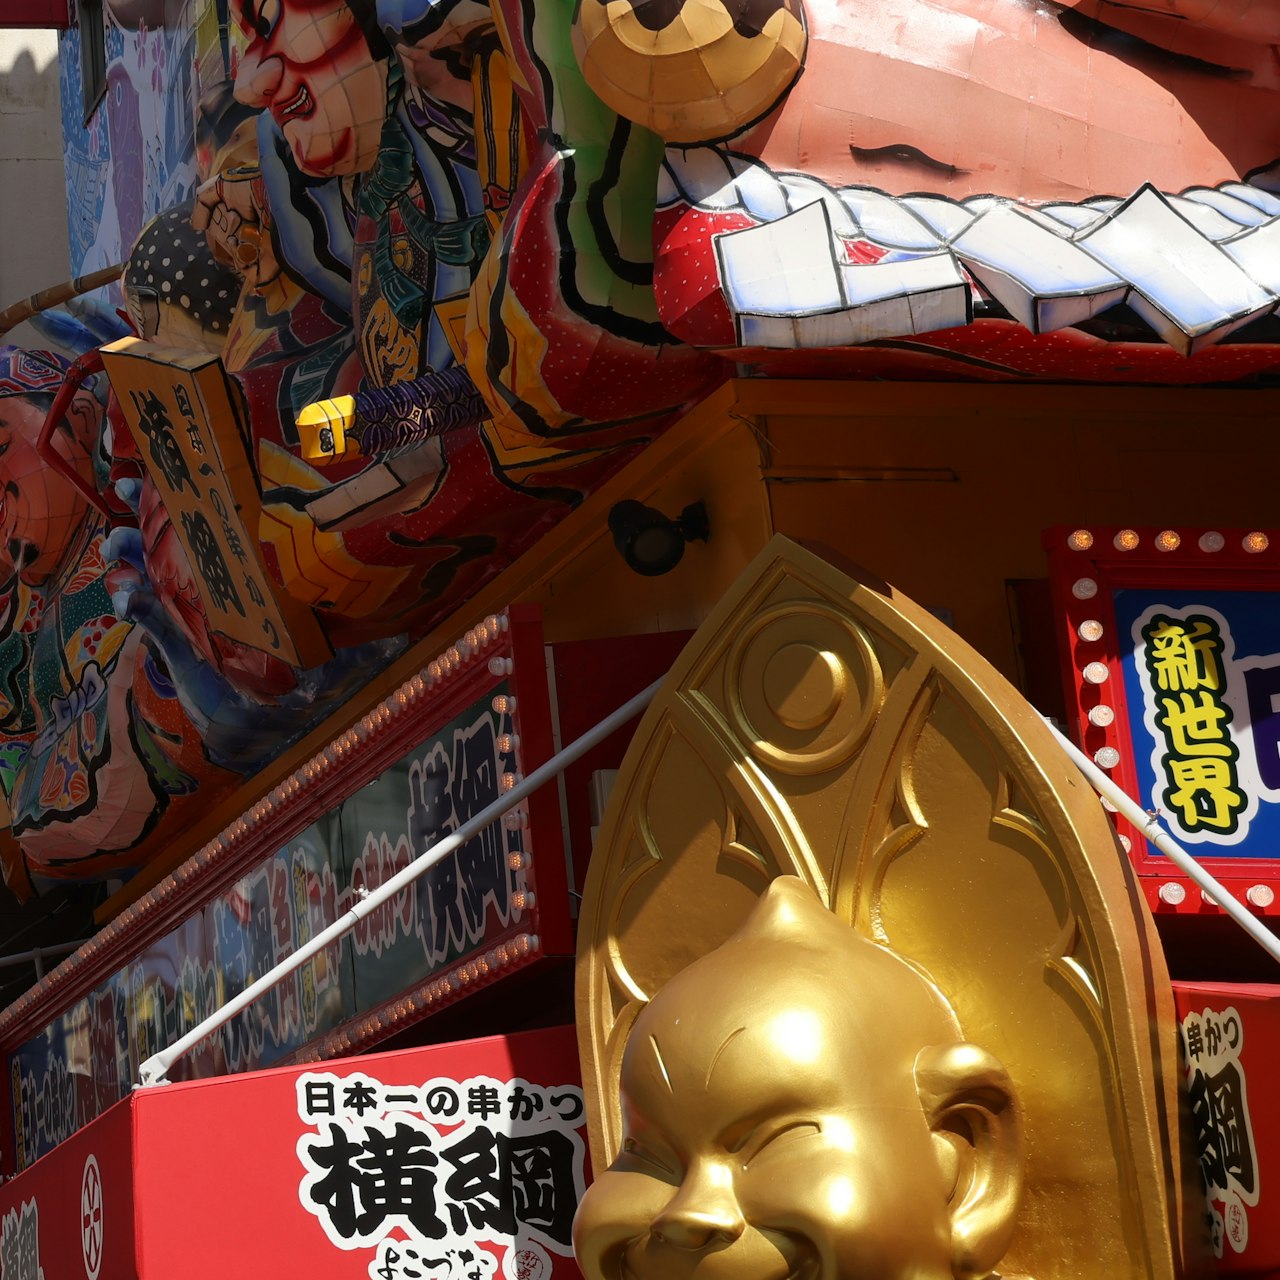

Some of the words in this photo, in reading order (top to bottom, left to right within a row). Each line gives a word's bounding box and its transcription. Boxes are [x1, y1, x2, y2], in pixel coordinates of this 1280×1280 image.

[1146, 616, 1244, 831] 新世界
[304, 1081, 583, 1121] 日本一の串かつ
[307, 1122, 581, 1246] 横綱
